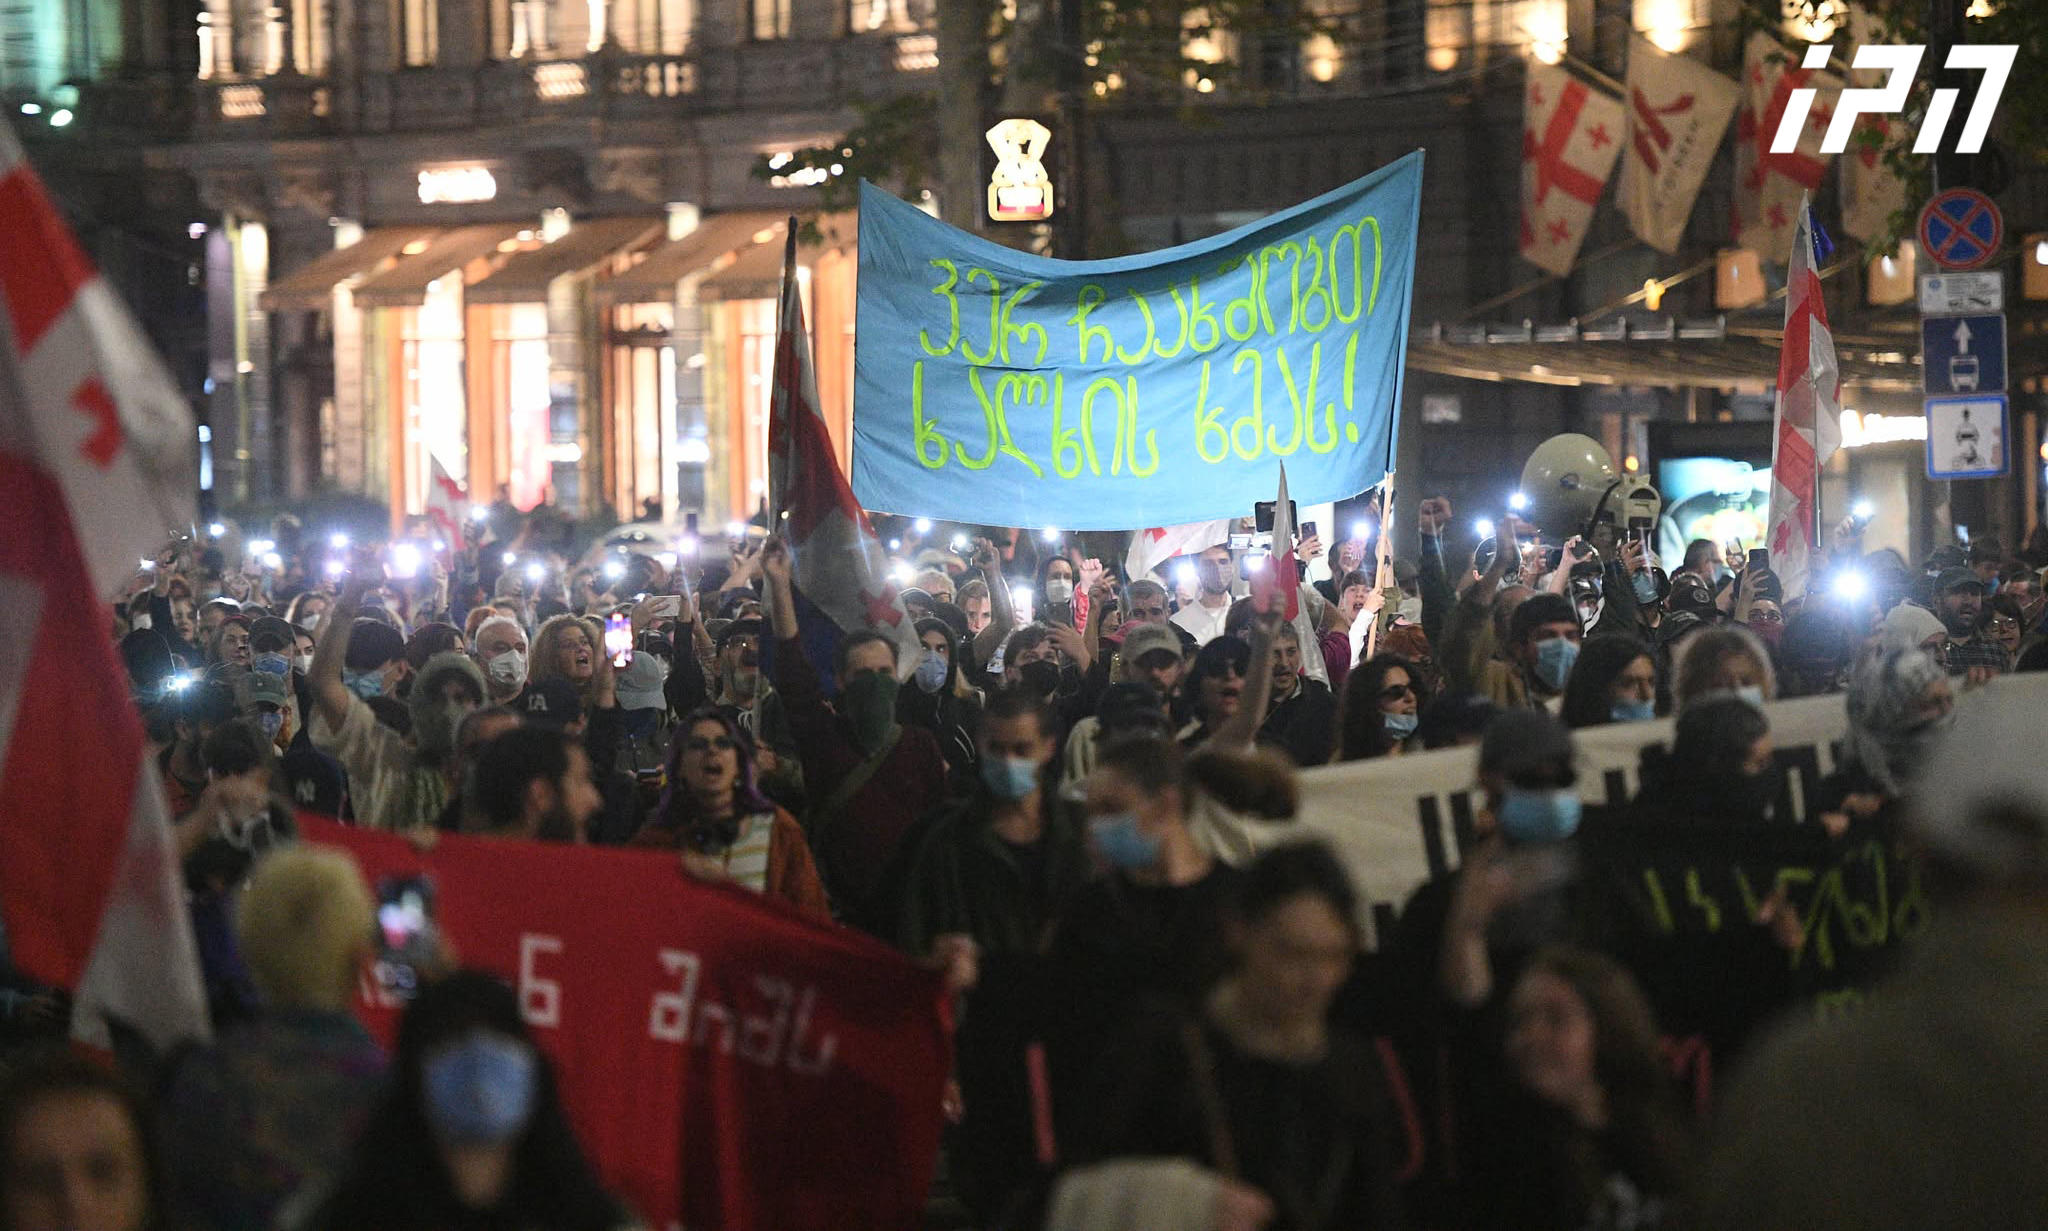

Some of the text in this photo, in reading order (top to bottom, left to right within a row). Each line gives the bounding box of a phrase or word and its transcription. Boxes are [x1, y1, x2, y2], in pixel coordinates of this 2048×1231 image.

[919, 258, 1048, 366] ვერ
[913, 330, 1359, 480] ხალხის ხმას!
